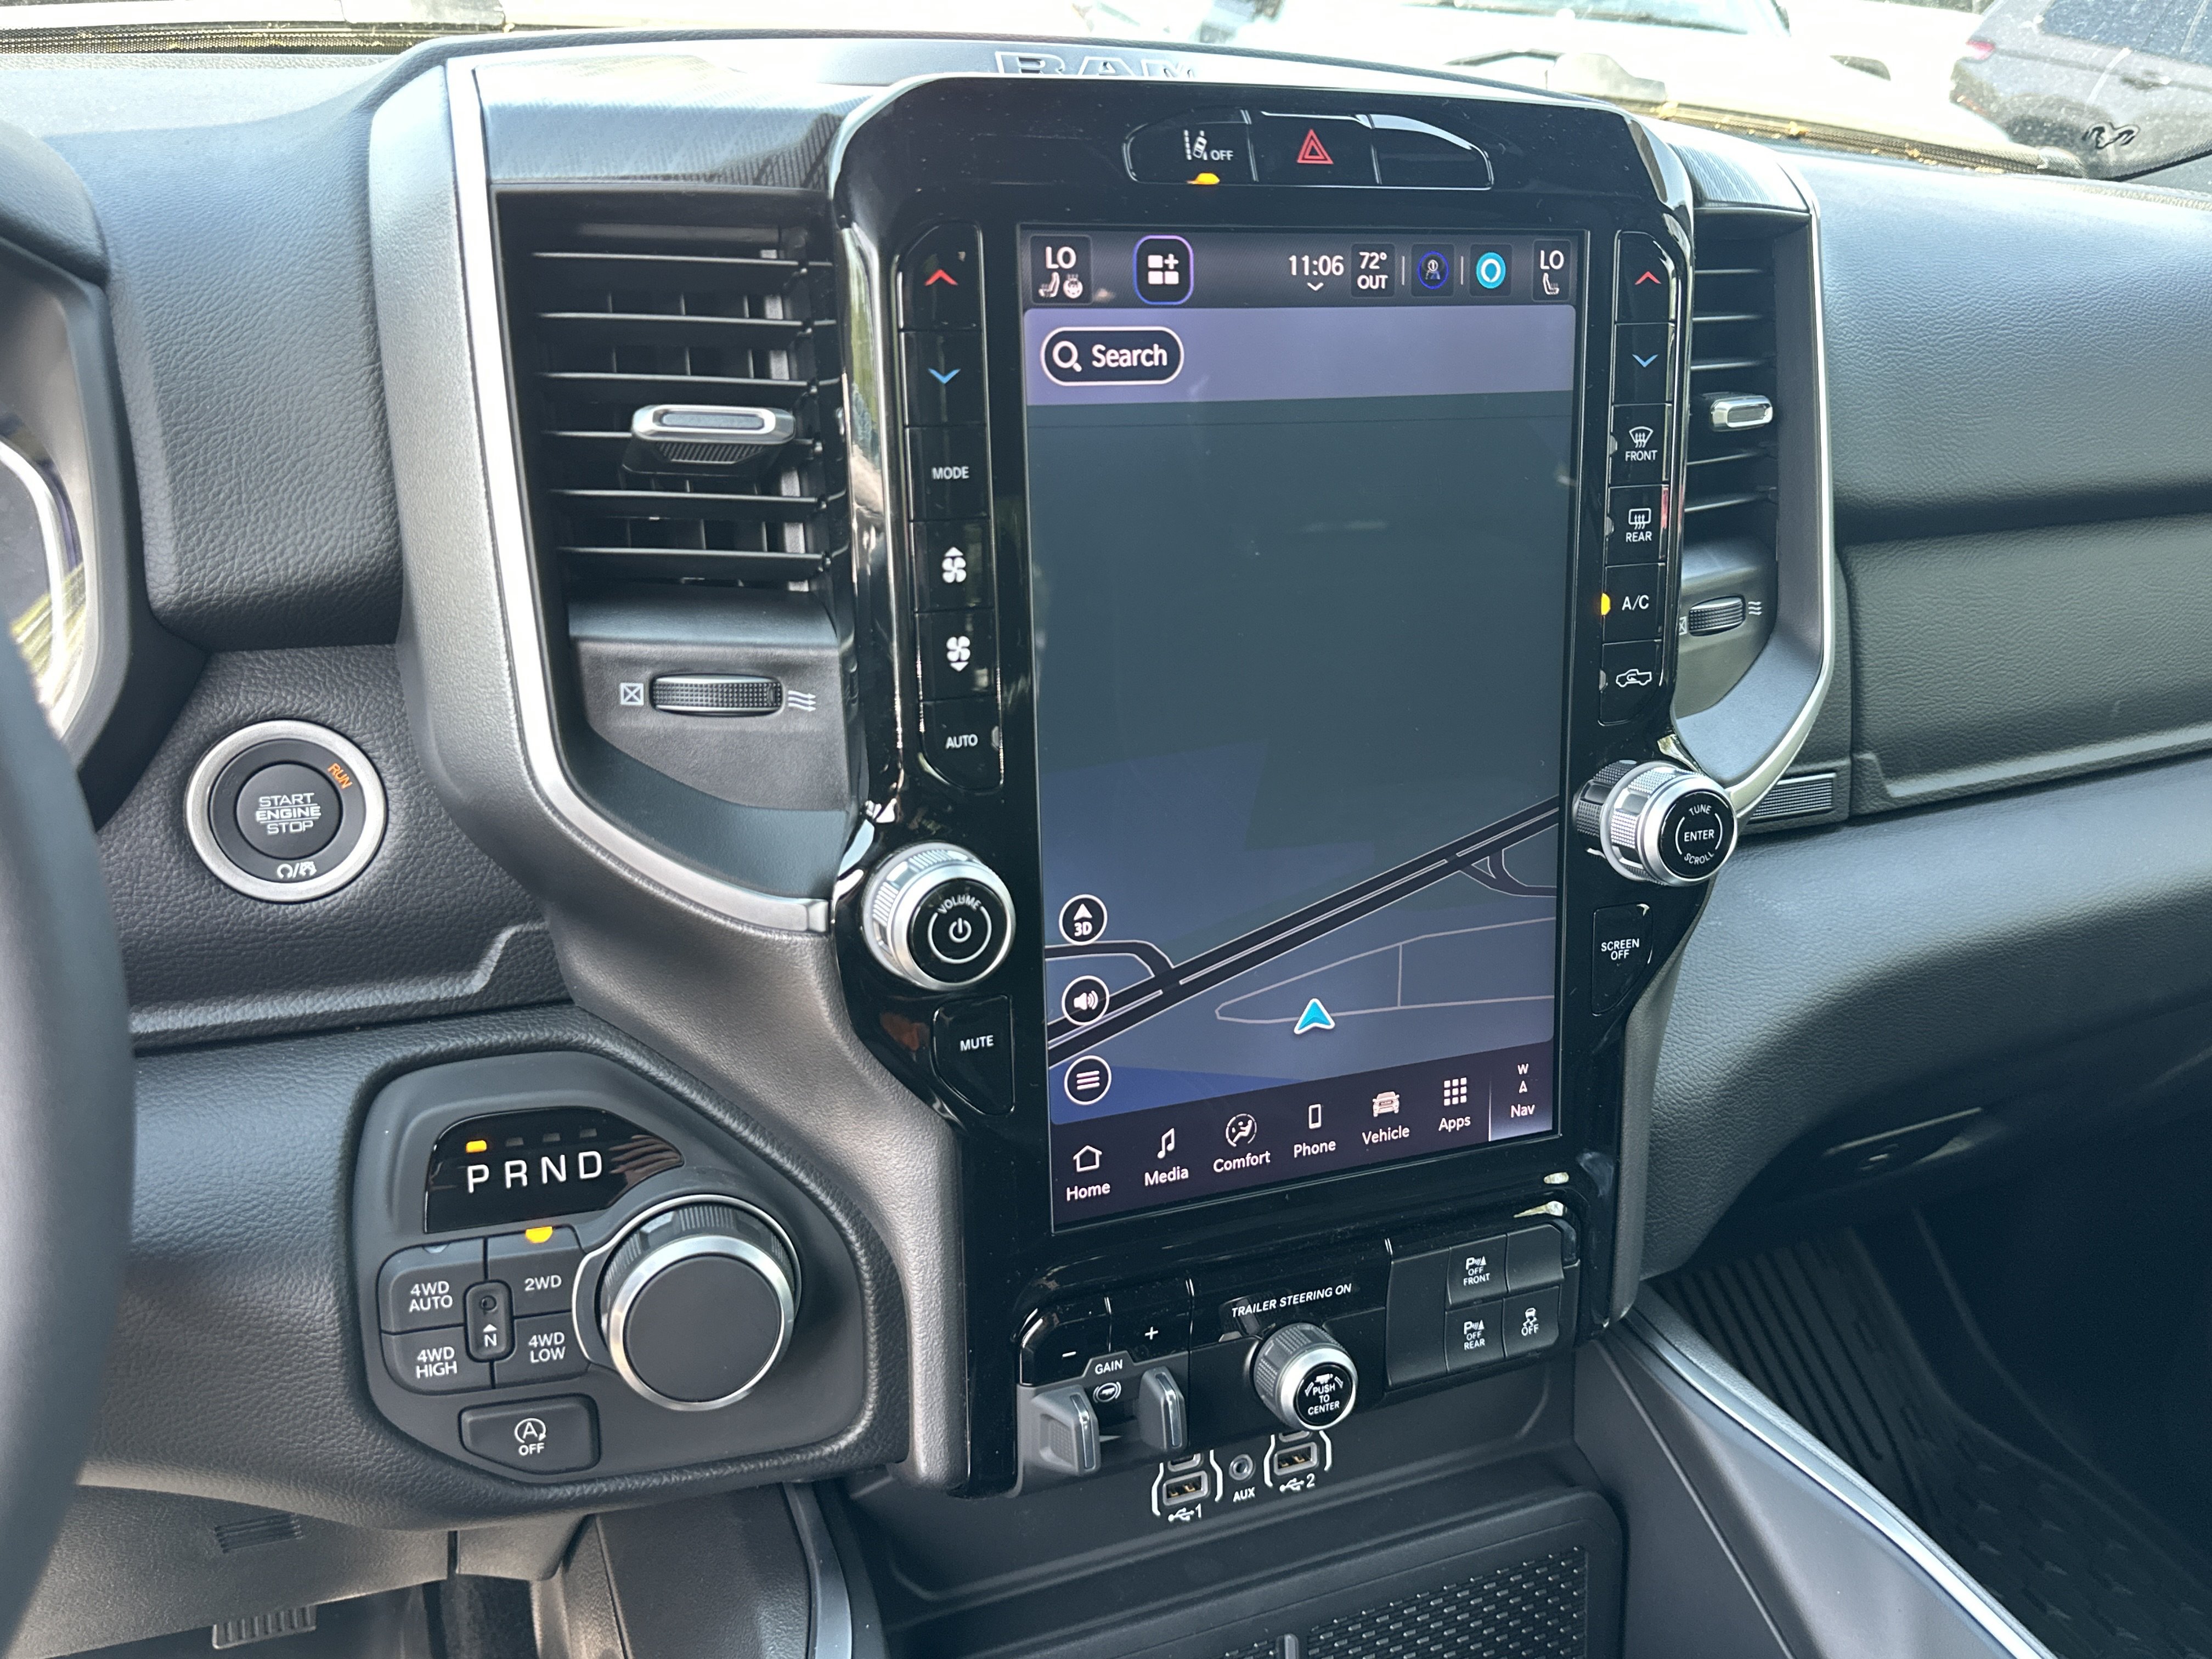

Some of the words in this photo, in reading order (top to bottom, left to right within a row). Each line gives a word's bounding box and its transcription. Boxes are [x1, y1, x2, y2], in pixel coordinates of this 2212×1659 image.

[994, 51, 1197, 78] RAM
[1210, 149, 1234, 161] OFF
[1046, 246, 1076, 269] LO
[1289, 255, 1344, 276] 11:06
[1540, 250, 1565, 270] LO
[1357, 274, 1389, 290] OUT
[1092, 343, 1167, 368] Search
[1625, 449, 1658, 461] FRONT
[932, 466, 969, 479] MODE
[1626, 531, 1652, 543] REAR
[1621, 596, 1649, 611] A/C
[945, 733, 978, 749] AUTO
[328, 763, 353, 789] RUN
[259, 792, 315, 807] START
[255, 806, 321, 821] ENGINE
[1689, 804, 1712, 816] TUNE
[267, 821, 314, 834] STOP
[1684, 829, 1714, 842] ENTER
[1684, 851, 1714, 865] SCROLL
[938, 895, 981, 915] VOLUME
[1074, 921, 1092, 936] 3D
[1601, 938, 1640, 952] SCREEN
[1610, 950, 1630, 961] OFF
[960, 1035, 994, 1051] MUTE
[1517, 1063, 1529, 1075] W
[1510, 1104, 1535, 1118] Nav
[1438, 1116, 1471, 1132] Apps
[1362, 1125, 1410, 1145] Vehicle
[1294, 1141, 1336, 1158] Phone
[1213, 1150, 1271, 1173] Comfort
[467, 1164, 489, 1193] P
[504, 1160, 528, 1189] R
[541, 1154, 567, 1184] N
[578, 1150, 602, 1180] D
[1144, 1166, 1189, 1186] Media
[1066, 1183, 1110, 1201] Home
[1463, 1272, 1490, 1286] FRONT
[1468, 1266, 1484, 1277] OFF
[410, 1280, 450, 1296] 4WD
[524, 1274, 562, 1291] 2WD
[409, 1295, 453, 1312] AUTO
[1231, 1299, 1278, 1318] TRAILER
[1279, 1287, 1333, 1307] STEERING
[1335, 1283, 1352, 1295] ON
[1466, 1330, 1482, 1341] OFF
[1521, 1324, 1539, 1336] OFF
[484, 1333, 497, 1347] N
[528, 1331, 566, 1348] 4WD
[1463, 1338, 1486, 1351] REAR
[416, 1346, 456, 1362] 4WD
[529, 1346, 566, 1363] LOW
[416, 1361, 458, 1379] HIGH
[1094, 1359, 1123, 1375] GAIN
[1312, 1384, 1336, 1395] PUSH
[1319, 1393, 1330, 1403] TO
[1307, 1400, 1340, 1416] CENTER
[518, 1443, 545, 1456] OFF
[1233, 1487, 1255, 1502] AUX
